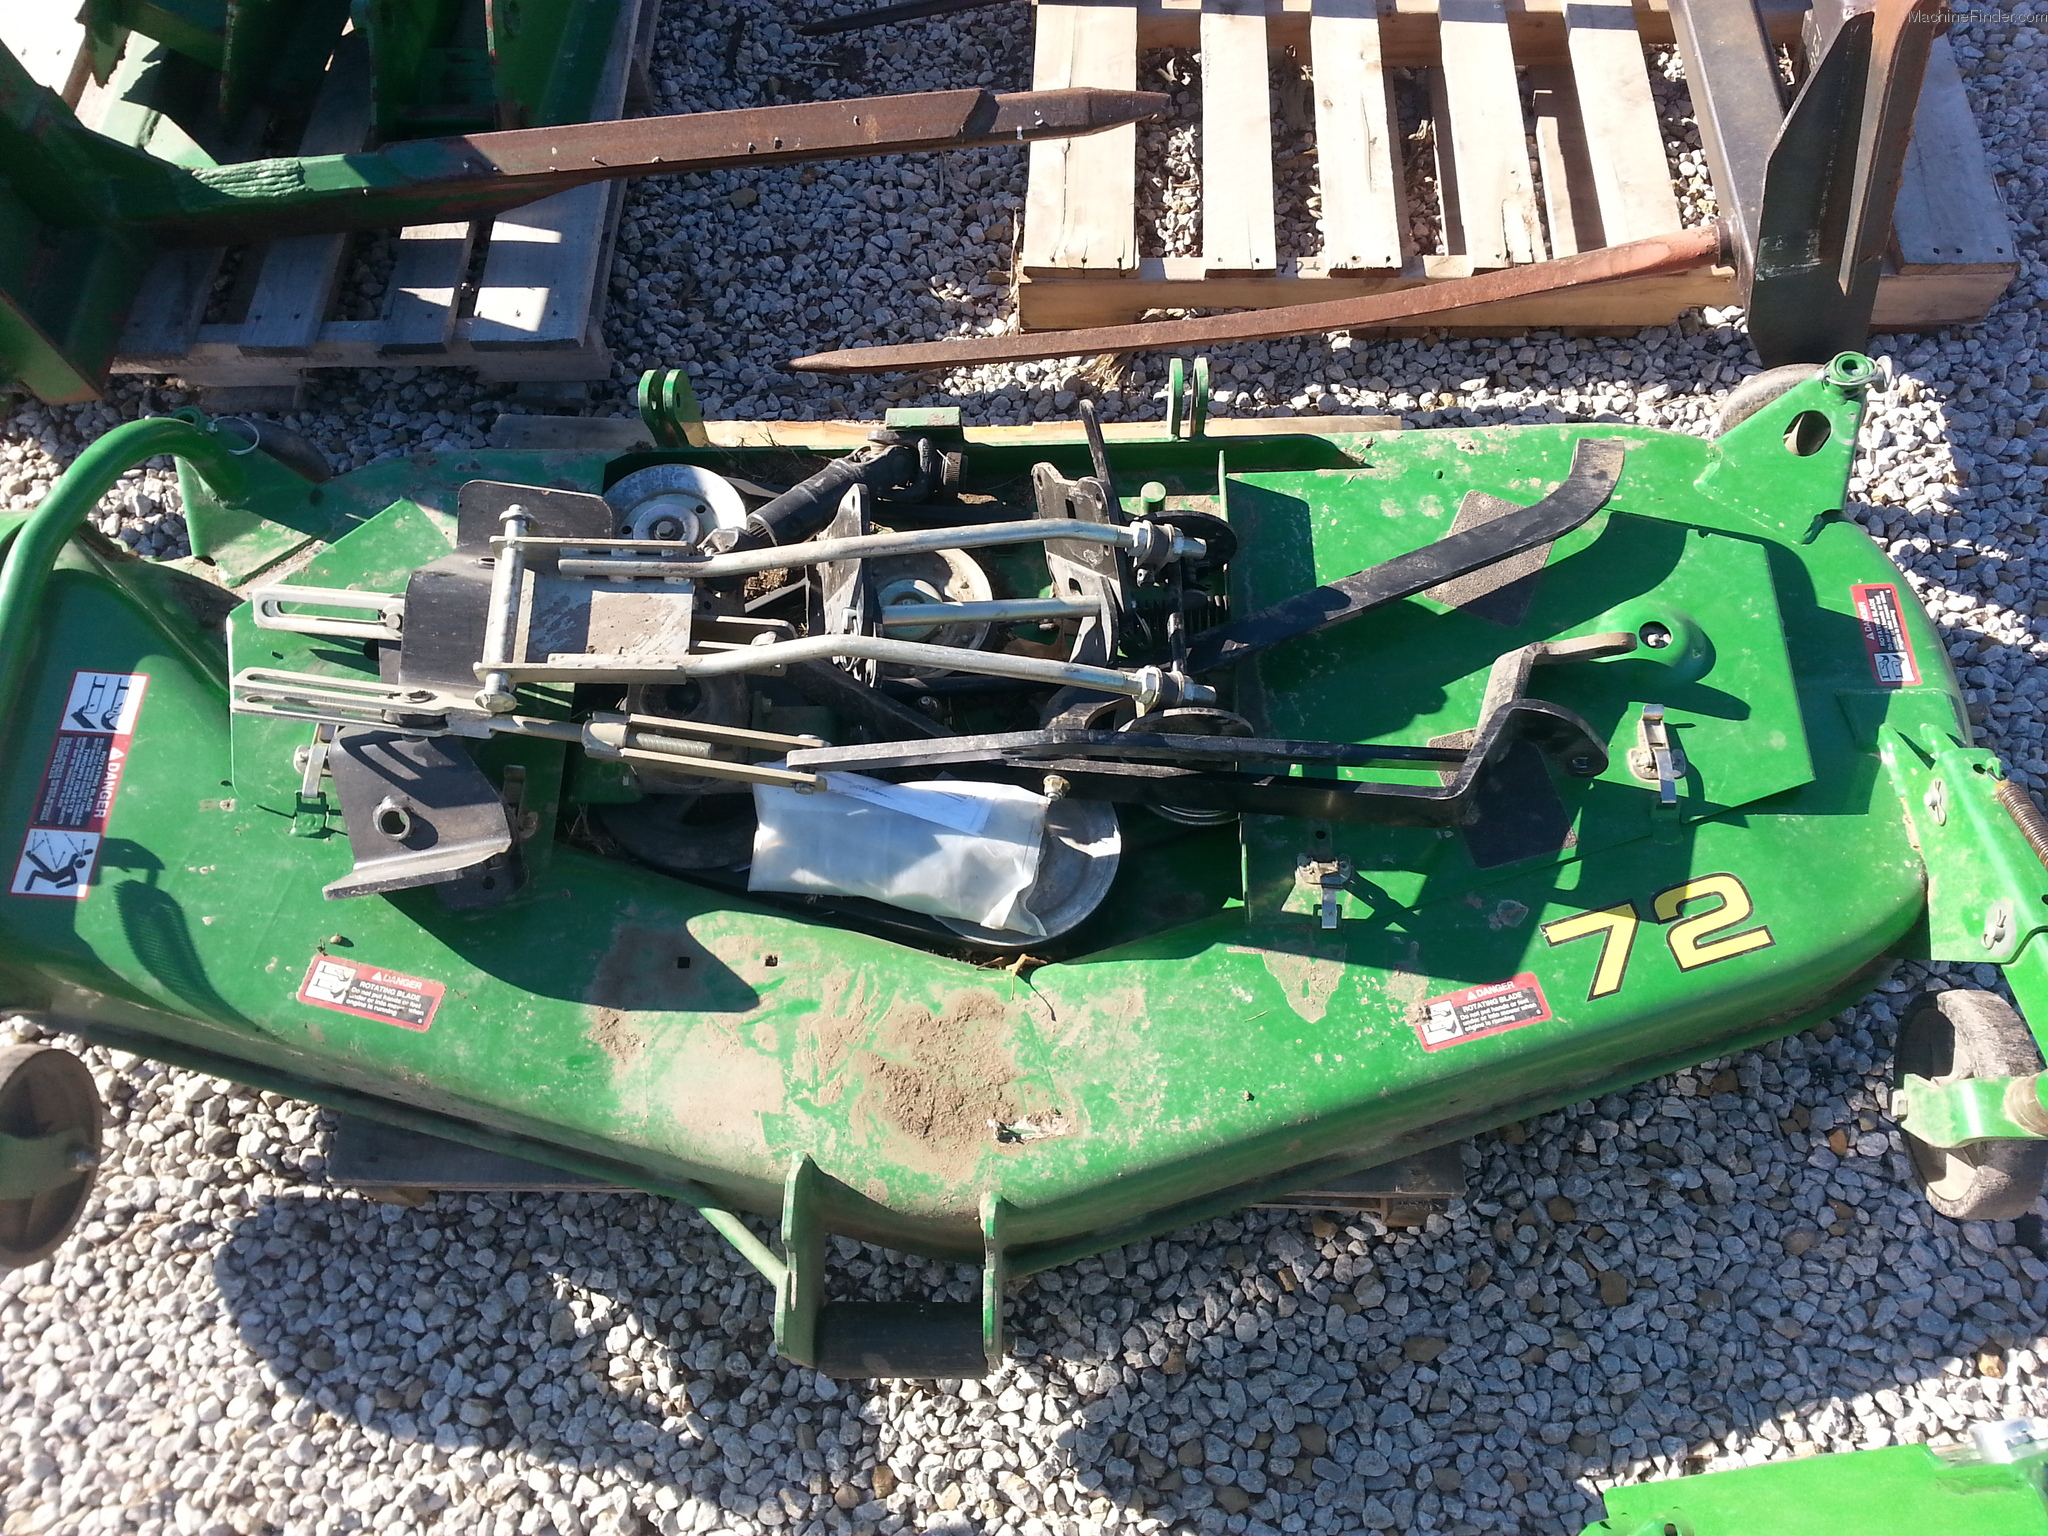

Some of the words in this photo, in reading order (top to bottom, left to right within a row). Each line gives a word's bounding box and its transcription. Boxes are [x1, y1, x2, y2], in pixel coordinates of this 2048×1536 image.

[1858, 602, 1872, 631] DANGER
[1868, 598, 1878, 617] BLADE
[1873, 617, 1885, 646] ROTATING
[76, 748, 90, 778] THROWN
[92, 751, 107, 786] ROTATING
[65, 780, 80, 812] OBJECTS
[84, 788, 96, 812] BLADE
[94, 763, 120, 817] DANGER
[1540, 872, 1776, 1002] 72
[351, 986, 361, 994] Do
[371, 992, 382, 1000] put
[359, 981, 396, 996] ROTATING
[396, 990, 421, 1002] BLADE
[382, 974, 423, 990] DANGER
[1476, 980, 1515, 998] DANGER
[345, 998, 367, 1009] engine
[373, 1006, 398, 1017] running
[1462, 997, 1498, 1013] ROTATING
[1498, 991, 1523, 1004] BLADE
[1460, 1013, 1469, 1021] Do
[1480, 1008, 1491, 1016] put
[1491, 1013, 1515, 1026] running
